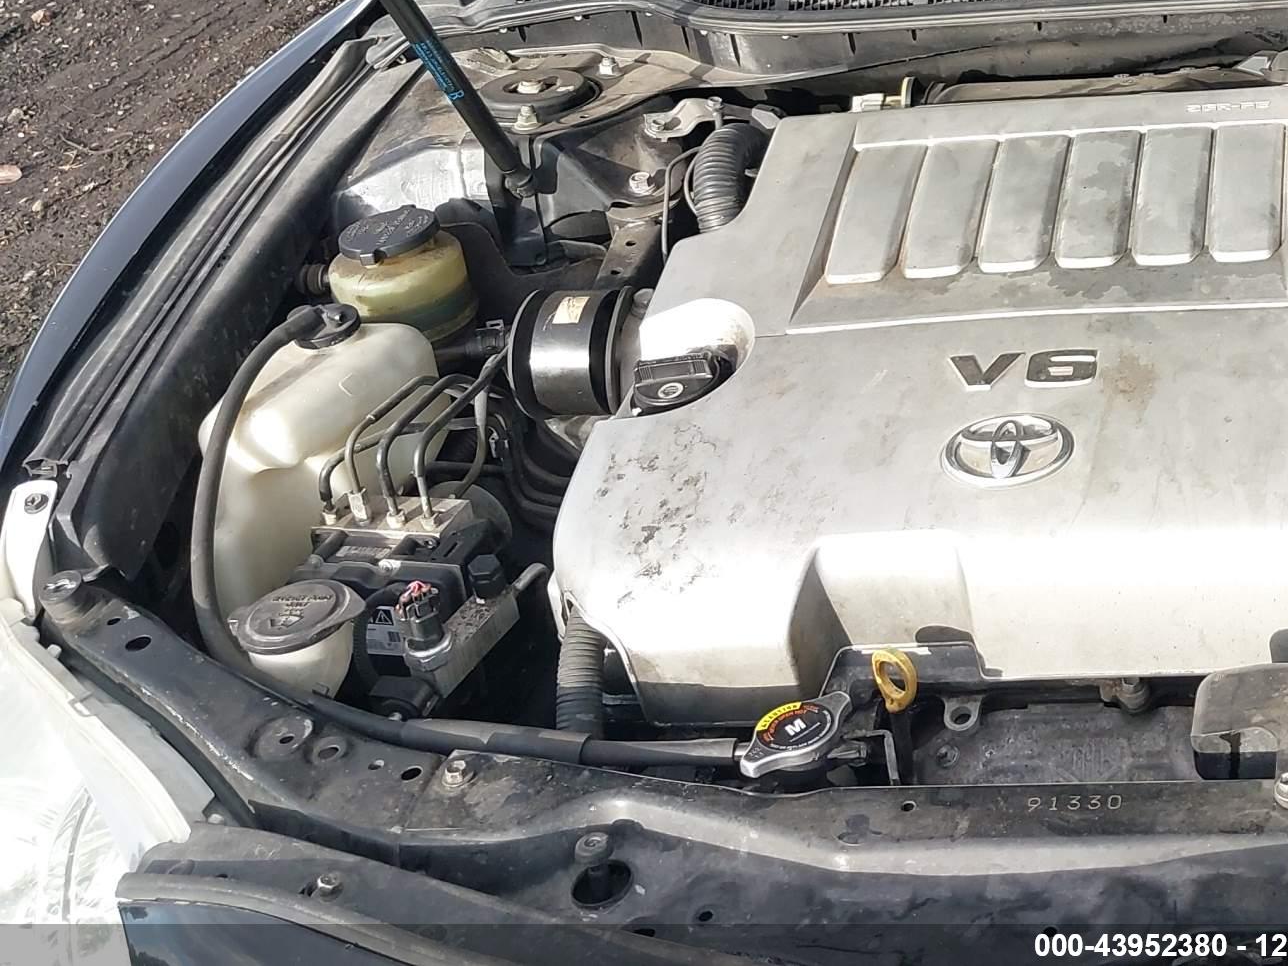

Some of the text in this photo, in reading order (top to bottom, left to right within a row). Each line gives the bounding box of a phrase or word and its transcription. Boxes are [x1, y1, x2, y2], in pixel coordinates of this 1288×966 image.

[946, 346, 1099, 392] V6
[784, 718, 807, 736] M
[1026, 794, 1123, 812] 91330
